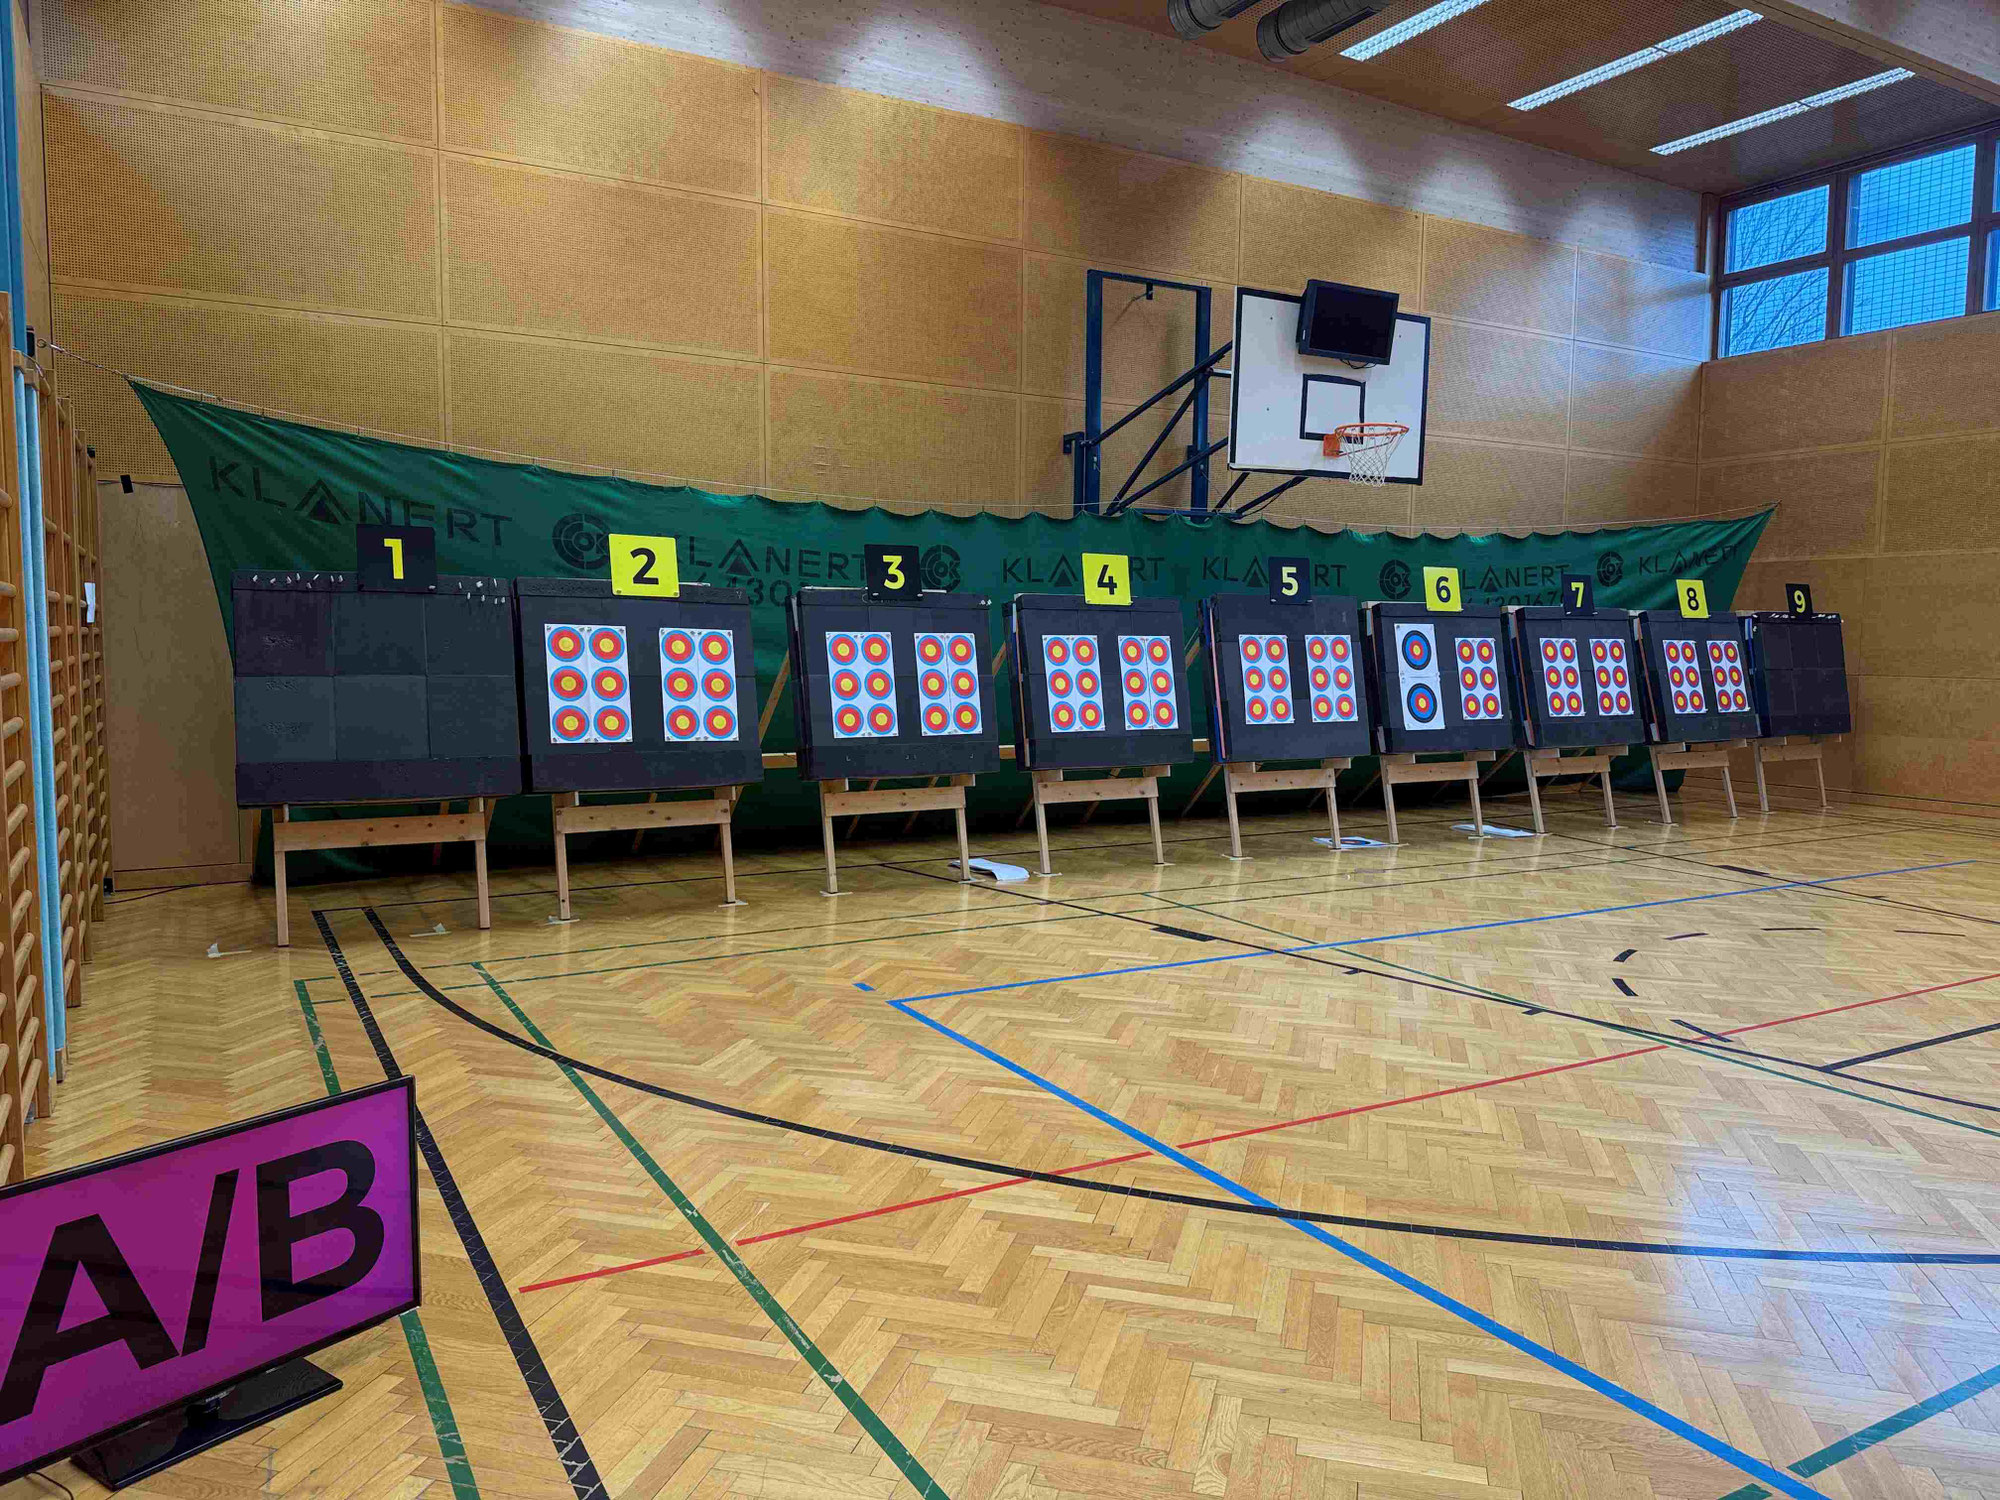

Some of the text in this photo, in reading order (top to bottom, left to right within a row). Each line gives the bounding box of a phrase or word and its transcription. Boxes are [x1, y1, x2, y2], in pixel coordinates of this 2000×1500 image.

[209, 456, 512, 546] KLANERT
[384, 538, 404, 579] 1
[630, 548, 659, 585] 2
[882, 555, 905, 590] 3
[1002, 554, 1165, 587] KLART
[1202, 555, 1347, 587] KLART
[1097, 564, 1118, 595] 4
[1281, 566, 1299, 596] 5
[1436, 576, 1451, 603] 6
[1571, 582, 1585, 608] 7
[1687, 587, 1700, 611] 8
[1794, 590, 1807, 613] 9
[0, 1140, 386, 1426] A/B
